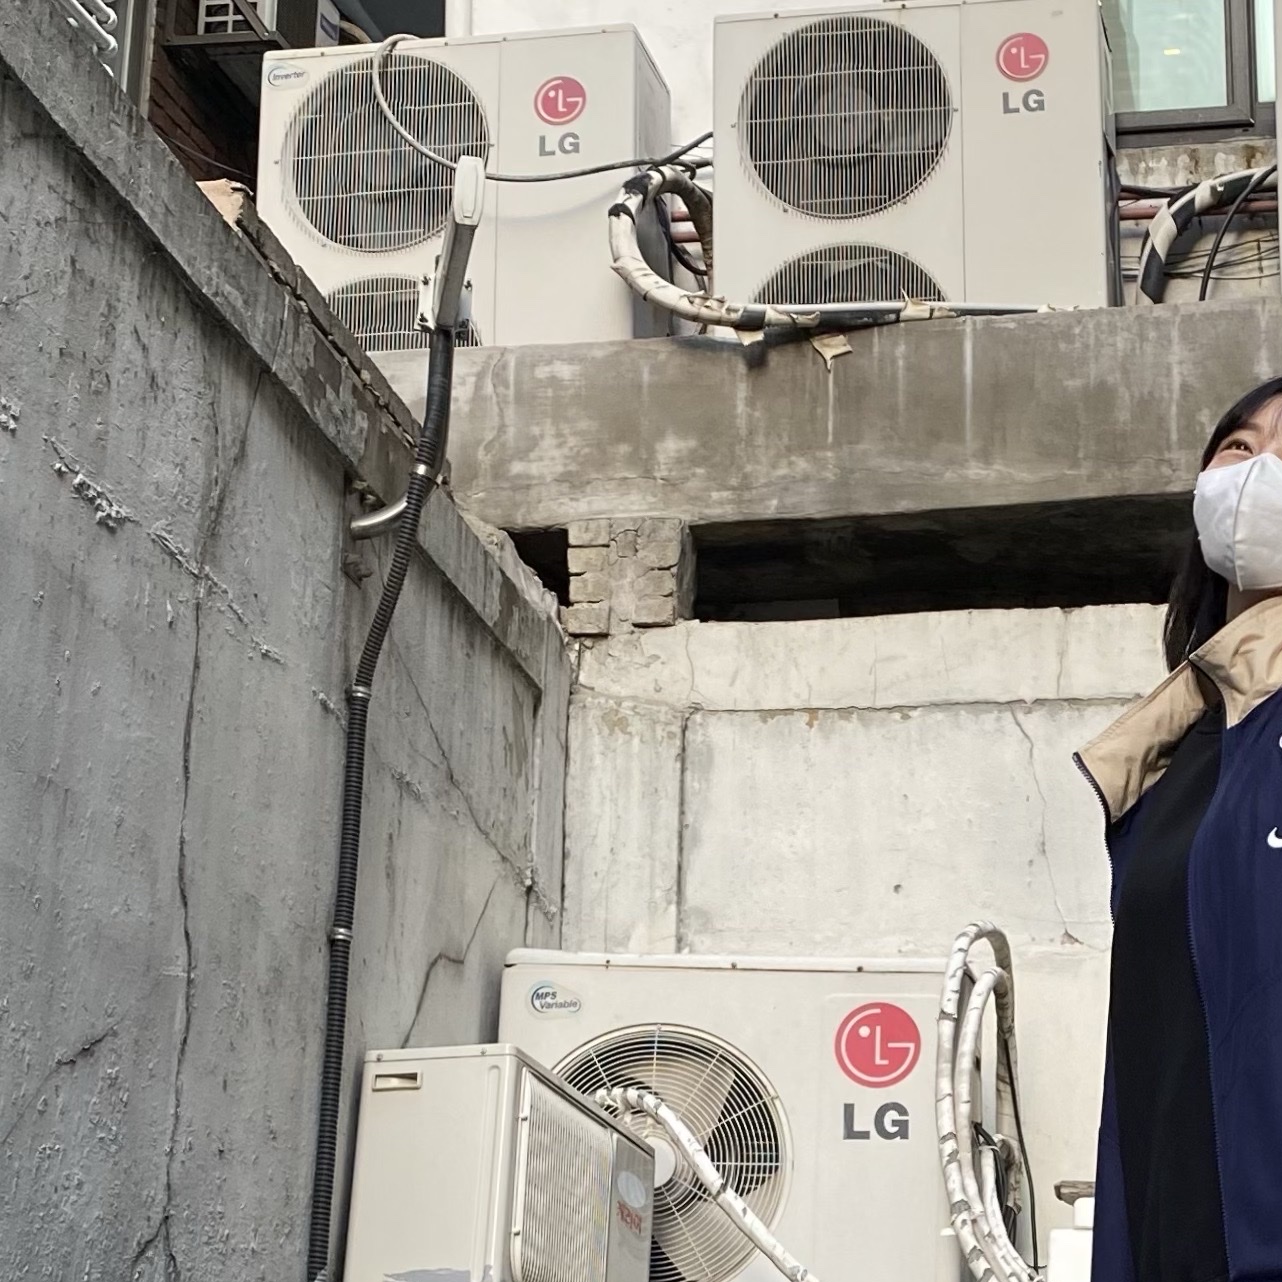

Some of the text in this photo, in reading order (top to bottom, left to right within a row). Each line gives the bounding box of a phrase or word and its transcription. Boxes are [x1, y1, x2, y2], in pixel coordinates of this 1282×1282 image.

[1002, 88, 1046, 115] LG
[538, 131, 581, 157] LG
[534, 991, 558, 1001] MPS
[539, 1000, 578, 1010] Variable
[842, 1101, 910, 1141] LG
